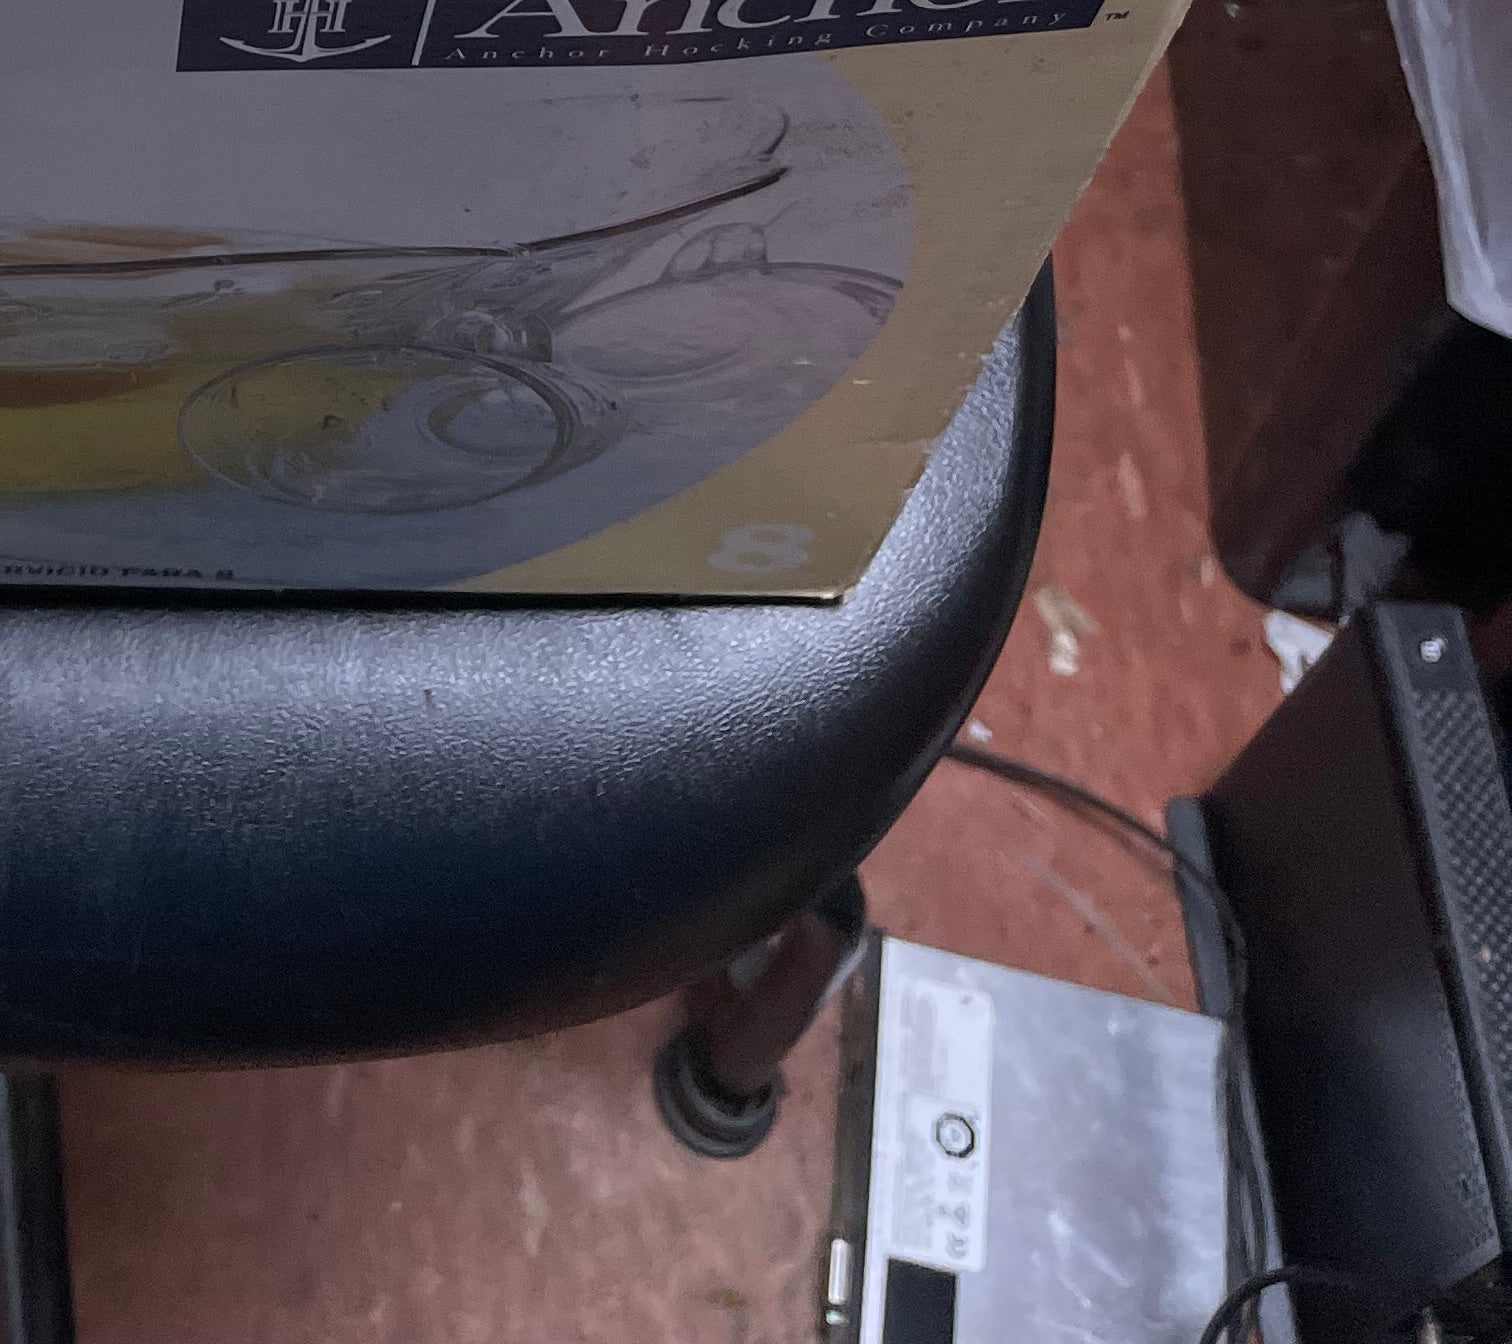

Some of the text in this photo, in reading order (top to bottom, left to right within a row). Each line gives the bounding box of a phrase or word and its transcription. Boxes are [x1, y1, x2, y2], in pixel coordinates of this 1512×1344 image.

[444, 11, 1066, 62] Anchor Hocking Company
